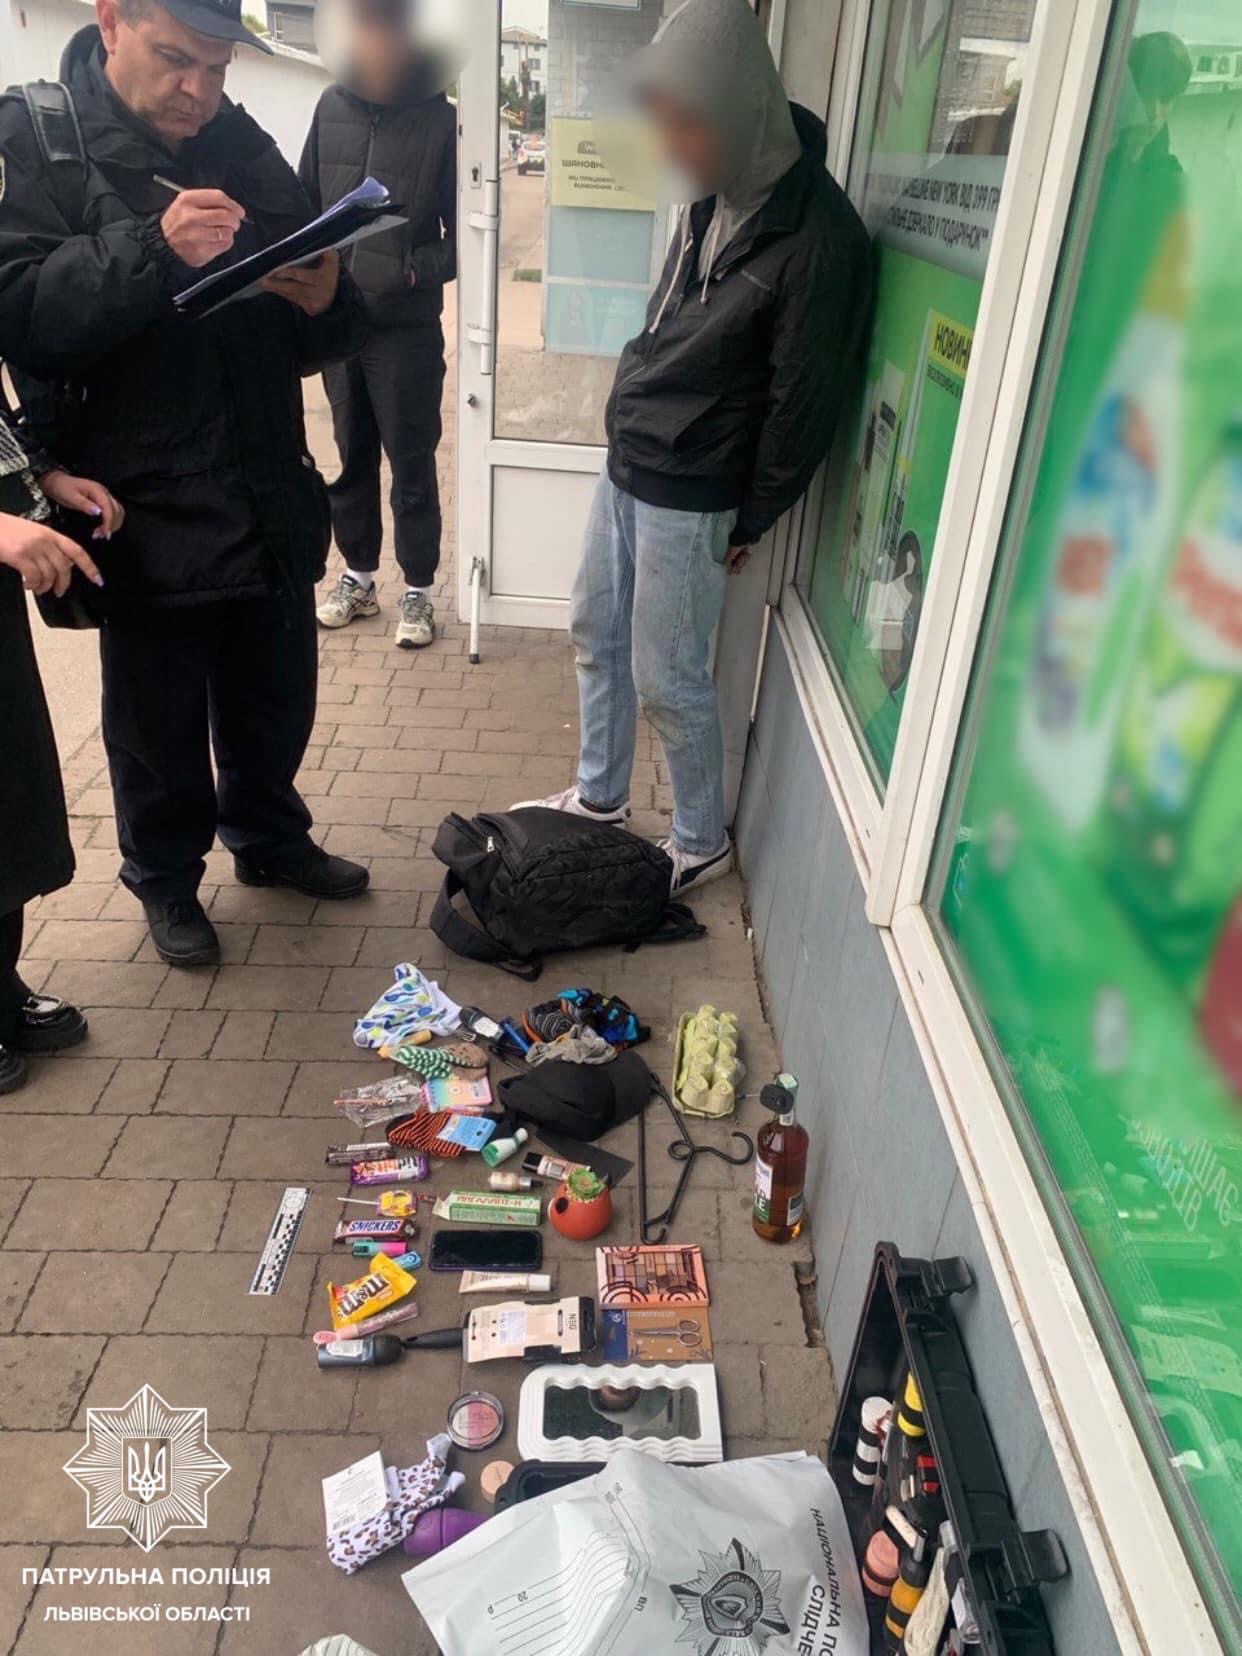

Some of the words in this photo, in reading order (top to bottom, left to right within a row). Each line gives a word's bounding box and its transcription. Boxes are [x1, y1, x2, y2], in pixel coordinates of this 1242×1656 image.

[934, 322, 973, 370] НОВИН
[349, 1220, 401, 1232] SNICKERS
[810, 1507, 842, 1628] НАЦІОНАЛЬНА
